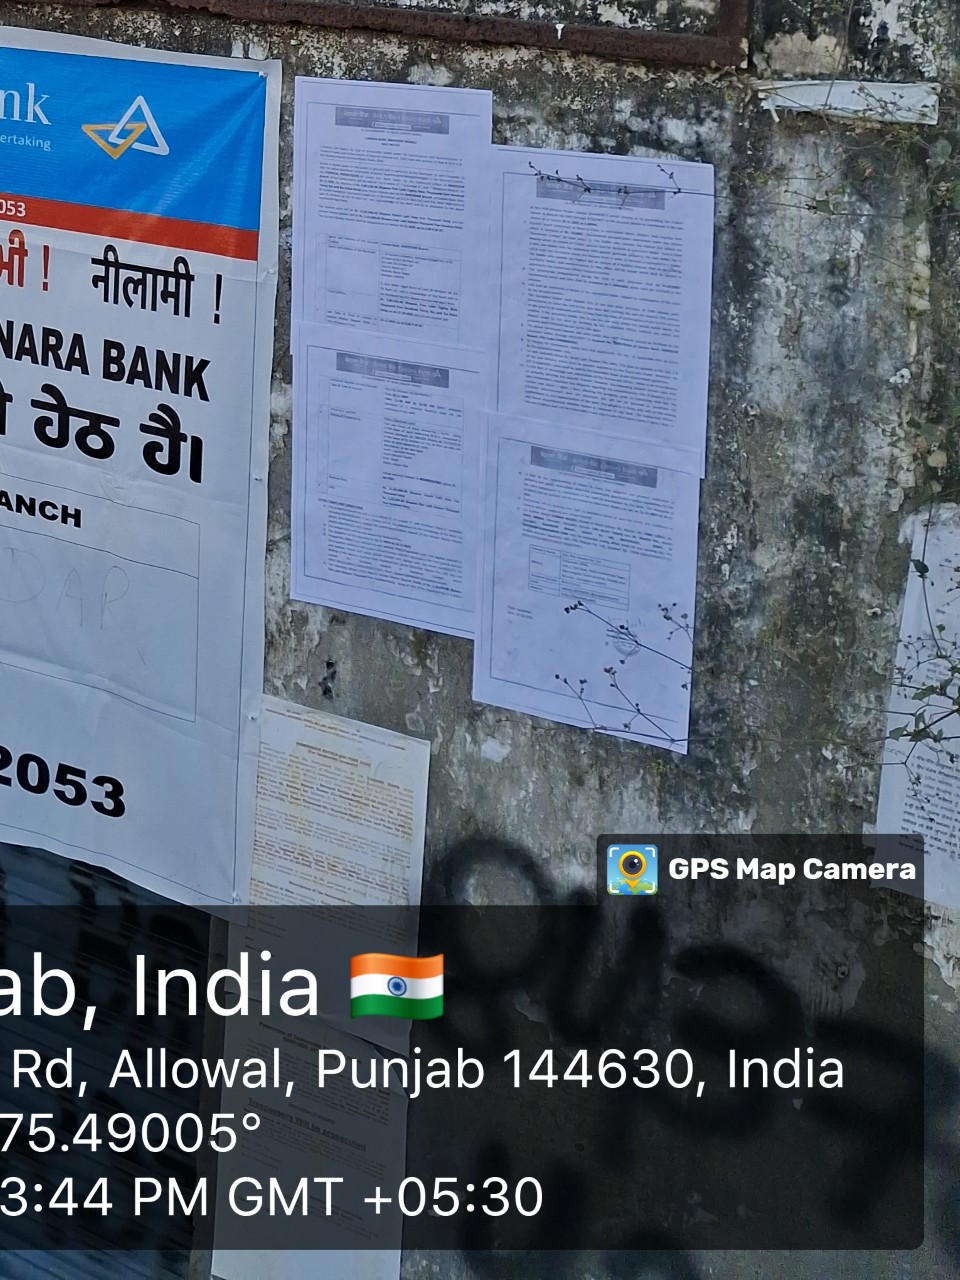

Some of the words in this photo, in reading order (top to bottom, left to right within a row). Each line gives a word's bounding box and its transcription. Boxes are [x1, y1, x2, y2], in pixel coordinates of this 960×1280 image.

[91, 244, 195, 318] नीलामी
[102, 338, 211, 402] BANK
[30, 384, 120, 460] ਹੇਠ
